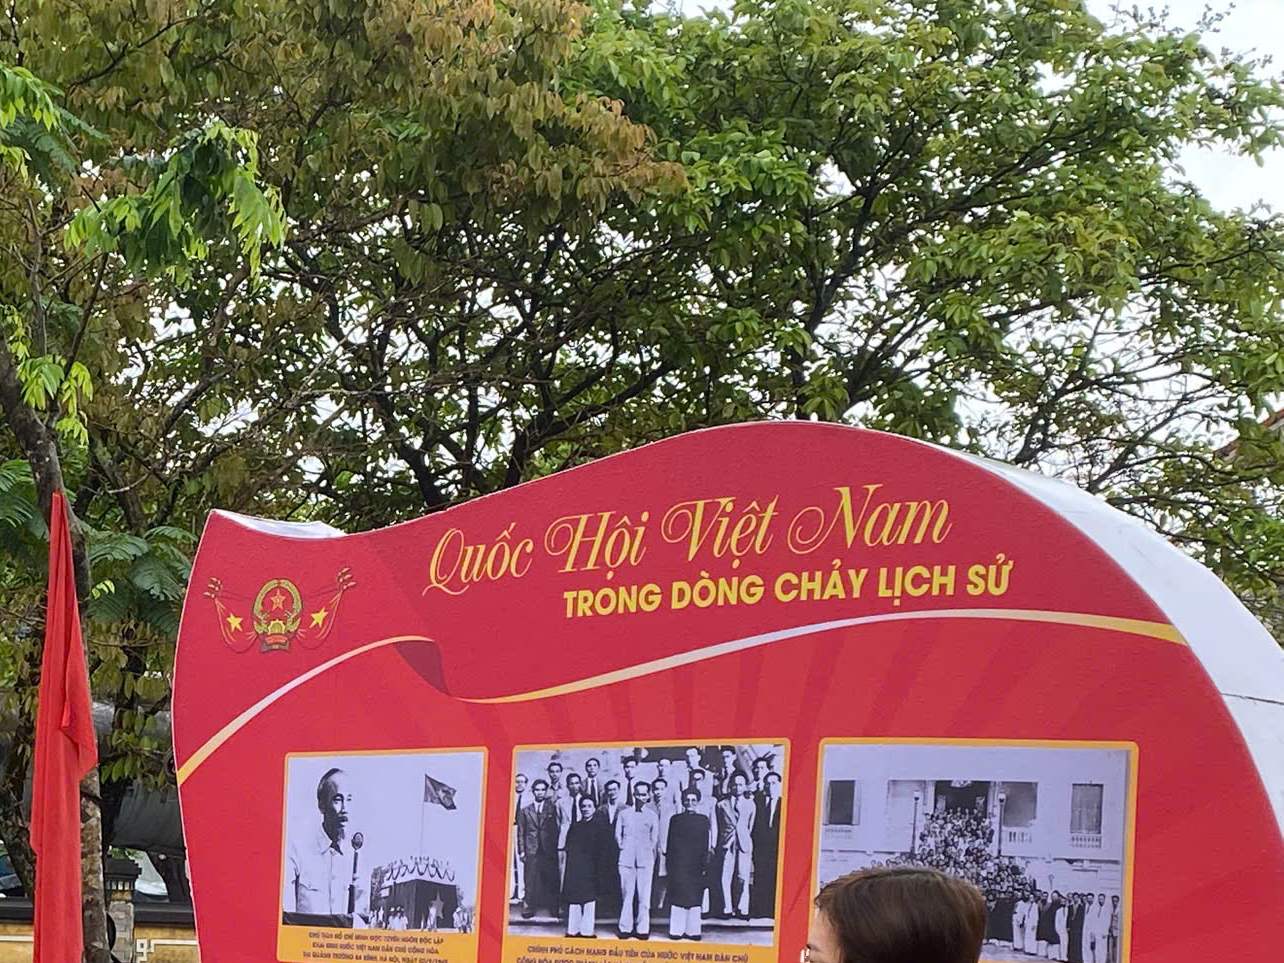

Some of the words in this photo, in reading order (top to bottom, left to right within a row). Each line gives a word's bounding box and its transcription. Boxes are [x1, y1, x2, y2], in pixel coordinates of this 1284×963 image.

[421, 521, 534, 597] Quốc
[544, 510, 649, 581] Hội
[660, 495, 780, 569] Việt
[787, 483, 953, 555] Nam
[563, 582, 662, 618] TRONG
[671, 570, 765, 609] DÒNG
[774, 558, 869, 603] CHẢY
[877, 564, 956, 607] LỊCH
[966, 552, 1014, 597] SỬ
